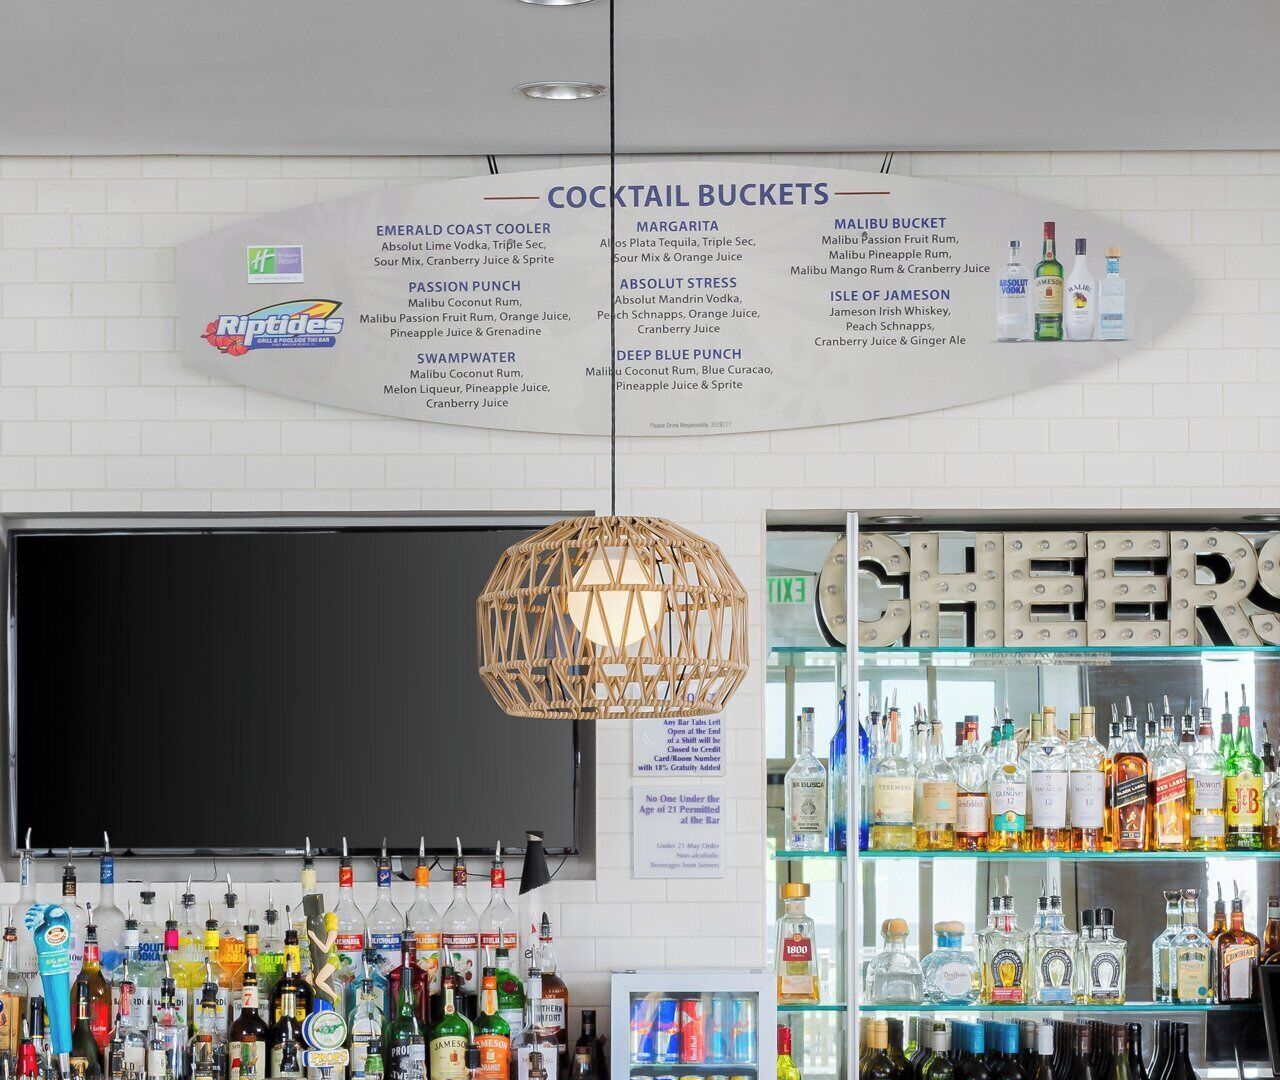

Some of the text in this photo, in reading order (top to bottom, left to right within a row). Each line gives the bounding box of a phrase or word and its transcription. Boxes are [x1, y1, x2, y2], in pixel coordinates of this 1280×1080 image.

[547, 183, 829, 208] COCKTAIL BUCKETS
[637, 221, 718, 232] MARGARITA
[835, 218, 946, 229] MALIBU BUCKET
[377, 223, 550, 236] EMERALD COAST COOLER
[382, 239, 546, 251] Absolut Lime Vodka, Triple Sec,
[409, 281, 520, 292] PASSION PUNCH
[620, 278, 736, 289] ABSOLUT STRESS
[1000, 279, 1028, 287] ABSOLUT
[831, 290, 949, 301] ISLE OF JAMESON
[1002, 286, 1025, 294] VODKA
[616, 294, 742, 304] Absolut Mandrin Vodka,
[830, 306, 950, 317] Jameson Irish Whiskey,
[216, 314, 344, 346] Riptides
[847, 321, 934, 332] Peach Schnapps,
[417, 352, 515, 364] SWAMPWATER
[617, 349, 741, 360] DEEP BLUE PUNCH
[426, 398, 508, 409] Cranberry Juice
[668, 728, 685, 736] Open
[671, 764, 697, 772] Gratuity
[1156, 778, 1186, 793] RED LABEL
[1117, 788, 1132, 796] BLACK
[1232, 788, 1259, 814] J&B
[640, 806, 654, 815] Age
[680, 816, 720, 824] at the Bar
[138, 943, 164, 951] SOLUT
[787, 946, 808, 954] 1800
[434, 1040, 467, 1051] JAMESO
